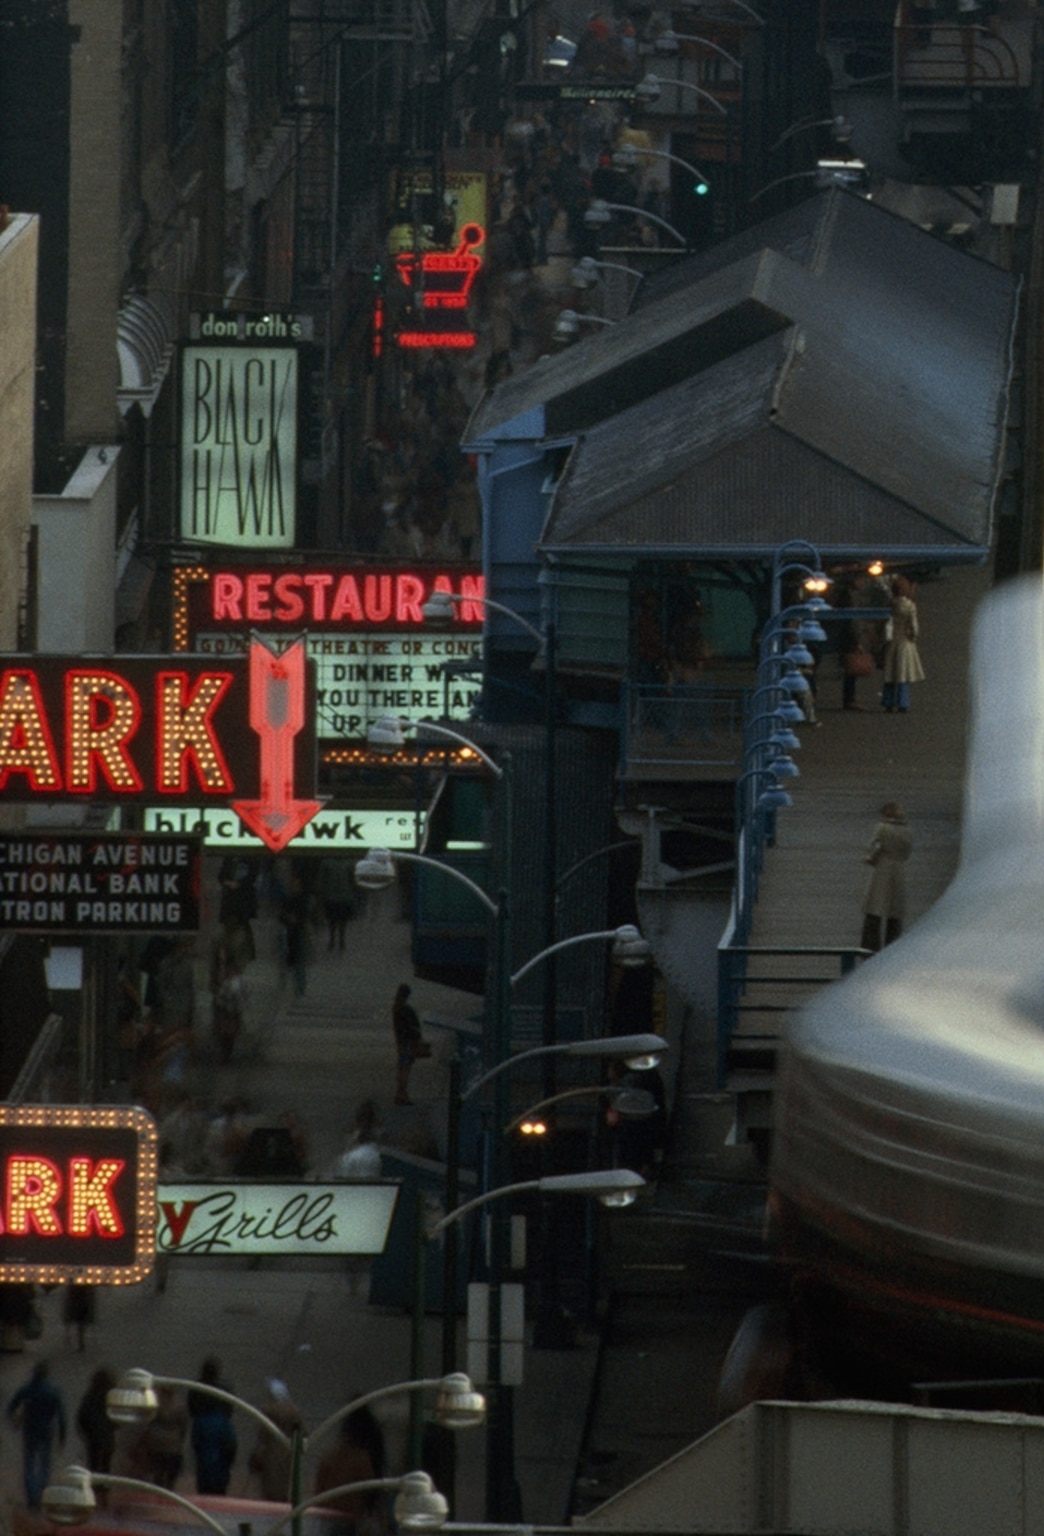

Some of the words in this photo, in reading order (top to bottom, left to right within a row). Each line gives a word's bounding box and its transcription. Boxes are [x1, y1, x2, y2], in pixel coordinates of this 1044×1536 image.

[201, 312, 238, 336] don
[245, 312, 301, 336] roth's
[194, 359, 293, 445] BLACK
[192, 449, 285, 536] HAWK
[311, 639, 392, 655] THEATRE
[402, 640, 423, 655] OR
[334, 664, 413, 682] DINNER
[317, 690, 359, 708] YOU
[369, 690, 440, 709] THERE
[155, 812, 364, 841] blacwk
[93, 844, 189, 867] AVENUE
[0, 871, 98, 894] TIONAL
[109, 873, 180, 895] BANK
[1, 900, 65, 922] TRON
[76, 901, 182, 924] PARKING
[0, 1153, 126, 1240] RK
[161, 1191, 338, 1252] Grills
